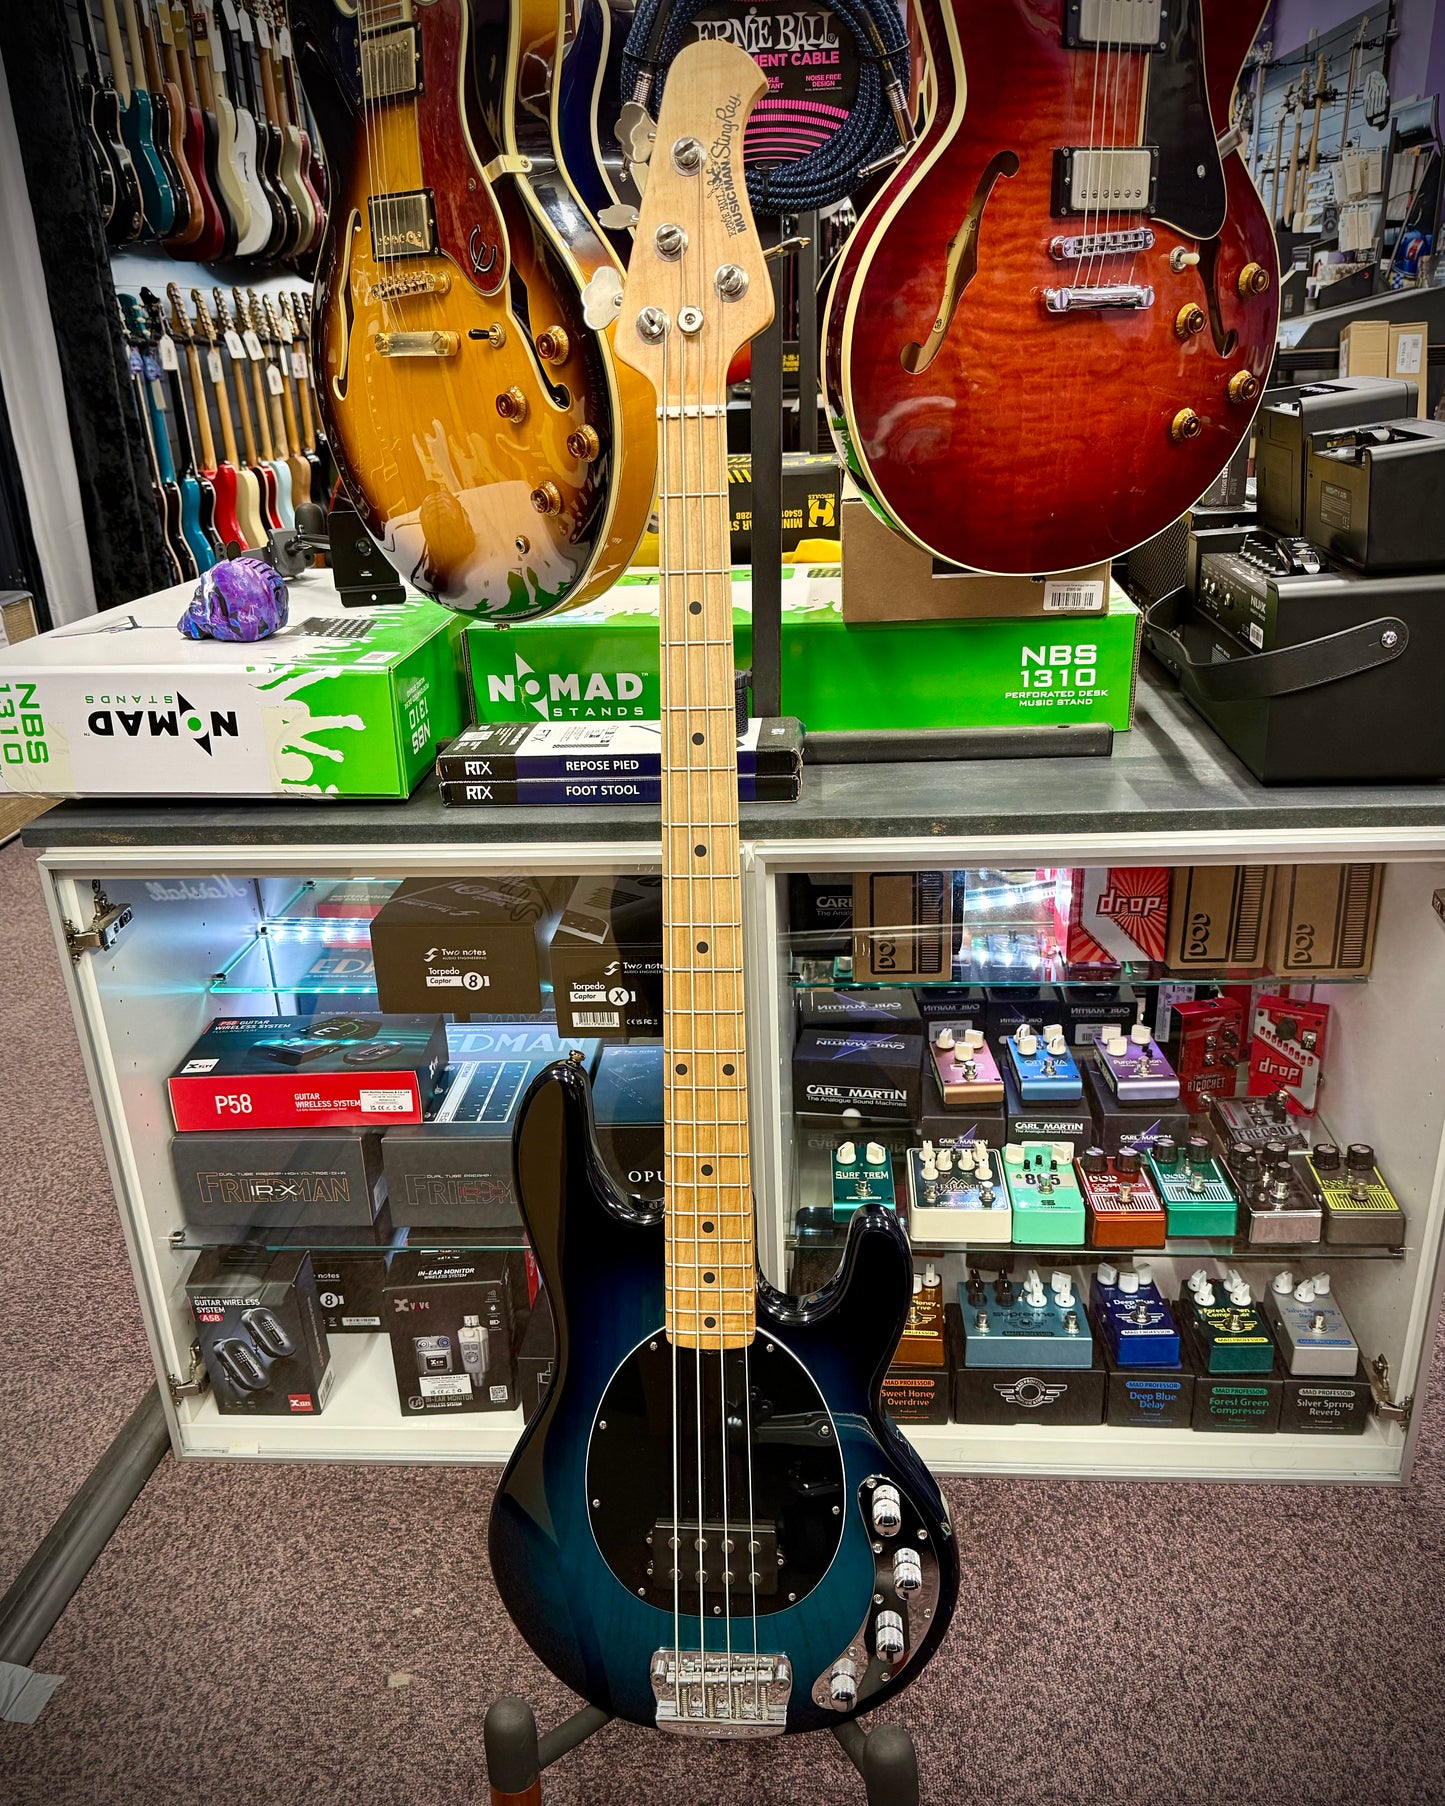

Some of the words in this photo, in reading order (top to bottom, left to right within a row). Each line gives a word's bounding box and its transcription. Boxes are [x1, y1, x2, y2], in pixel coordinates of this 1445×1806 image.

[774, 12, 840, 51] BALL
[791, 51, 840, 65] CABLE
[1021, 644, 1097, 666] NBS
[1020, 668, 1096, 688] 1310
[487, 663, 644, 711] NOMAD
[85, 695, 173, 703] STANDS
[1005, 690, 1076, 699] PERFORATED
[1078, 689, 1109, 698] DESK
[1019, 699, 1054, 707] MUSIC
[1056, 698, 1094, 706] STAND
[409, 696, 429, 730] 1310
[553, 707, 644, 717] STANDS
[15, 684, 49, 763] NBS
[411, 718, 431, 755] NBS
[465, 761, 493, 776] RTX
[566, 760, 610, 771] REPOSE
[613, 760, 640, 770] PIED
[466, 785, 494, 800] RTX
[566, 785, 598, 796] FOOT
[601, 784, 641, 795] STOOL
[1099, 888, 1163, 917] drop
[428, 967, 460, 976] Torpedo
[469, 975, 478, 987] 8
[572, 982, 605, 991] Torpedo
[614, 991, 624, 1002] X
[1258, 1057, 1300, 1080] drop
[1187, 1076, 1226, 1092] RICOCHET
[294, 1092, 321, 1100] GUITAR
[806, 1085, 842, 1096] CARL
[848, 1088, 907, 1101] MARTIN
[214, 1093, 253, 1115] P58
[295, 1100, 332, 1109] WIRELESS
[333, 1099, 361, 1107] SYSTEM
[1015, 1121, 1039, 1129] CARL
[1043, 1122, 1083, 1131] MARTIN
[197, 1172, 351, 1203] FRIEDMAN
[251, 1185, 298, 1196] IR-X
[326, 1294, 333, 1306] 8
[881, 1389, 907, 1397] Sweet
[908, 1390, 935, 1399] Honey
[1130, 1392, 1153, 1401] Deep
[1155, 1392, 1177, 1401] Blue
[1139, 1401, 1165, 1409] Delay
[1209, 1397, 1238, 1406] Forest
[1240, 1398, 1269, 1406] Green
[1297, 1398, 1322, 1407] Silver
[1323, 1399, 1354, 1410] Spring
[1210, 1405, 1266, 1415] Compressor
[1309, 1407, 1340, 1416] Reverb
